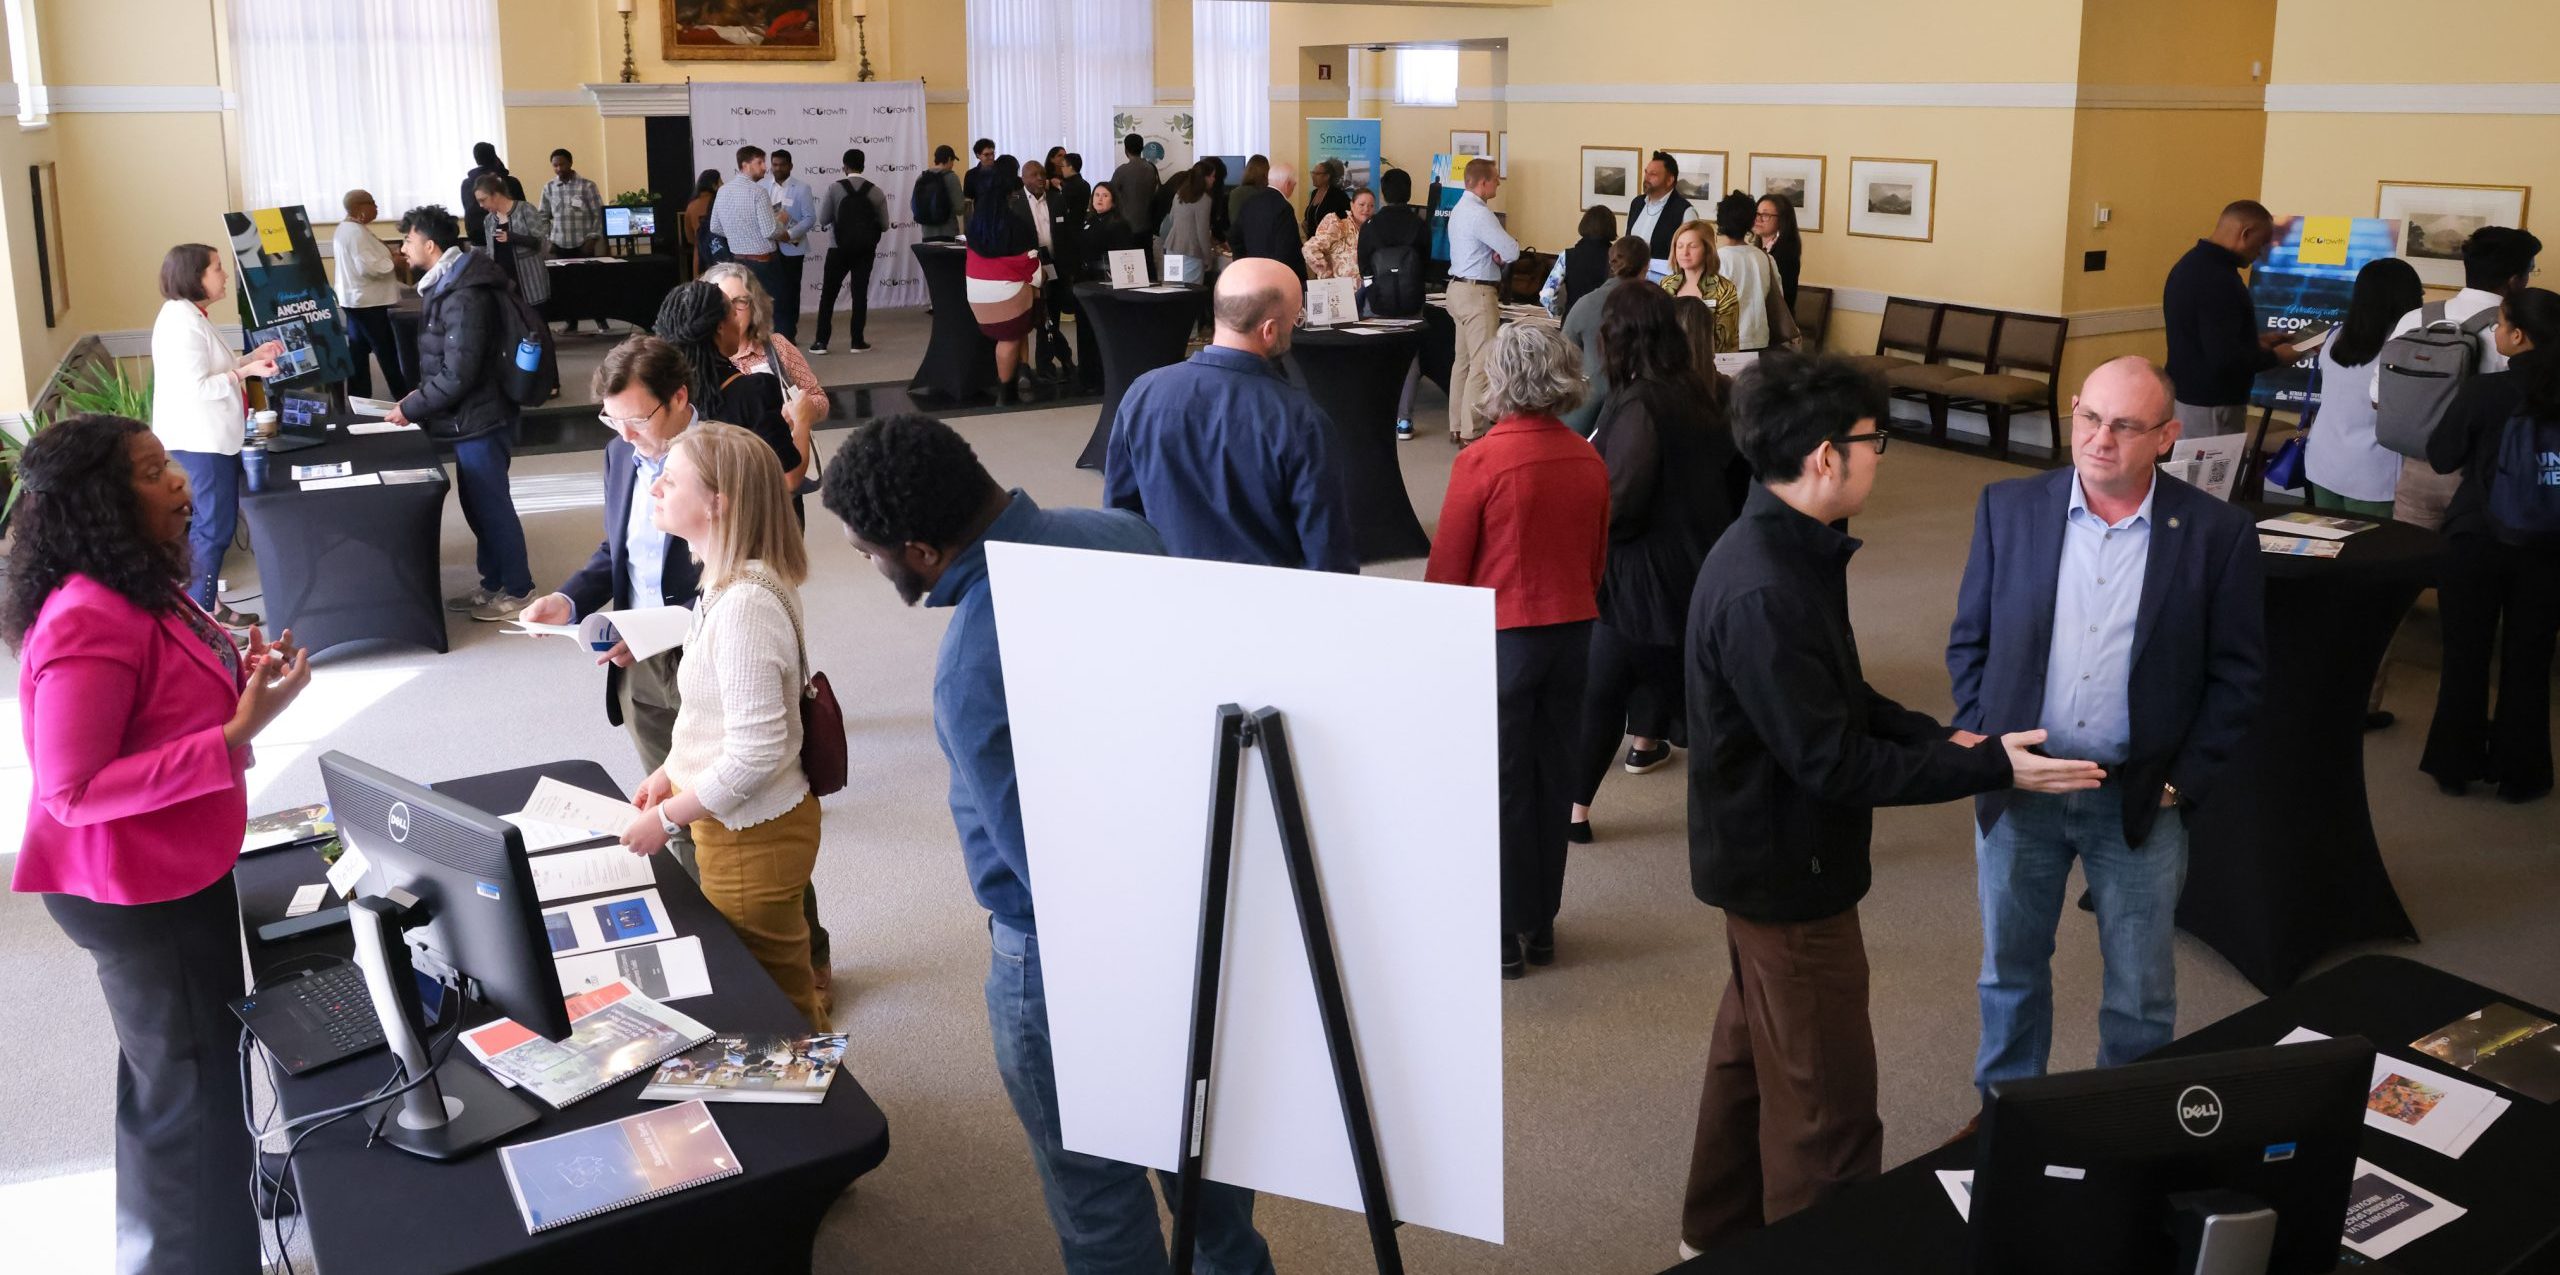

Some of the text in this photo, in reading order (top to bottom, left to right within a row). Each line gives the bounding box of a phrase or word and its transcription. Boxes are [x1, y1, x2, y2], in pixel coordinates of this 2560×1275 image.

[730, 106, 776, 116] NCGrowth
[802, 106, 848, 116] NCGrowth
[873, 105, 915, 115] NCGrowth
[773, 136, 818, 146] NCGrowth
[849, 134, 894, 145] NCGrowth
[1320, 132, 1367, 146] SmartUp
[277, 299, 318, 318] ANCHOR
[390, 814, 407, 830] DELL
[2183, 1104, 2218, 1119] DELL
